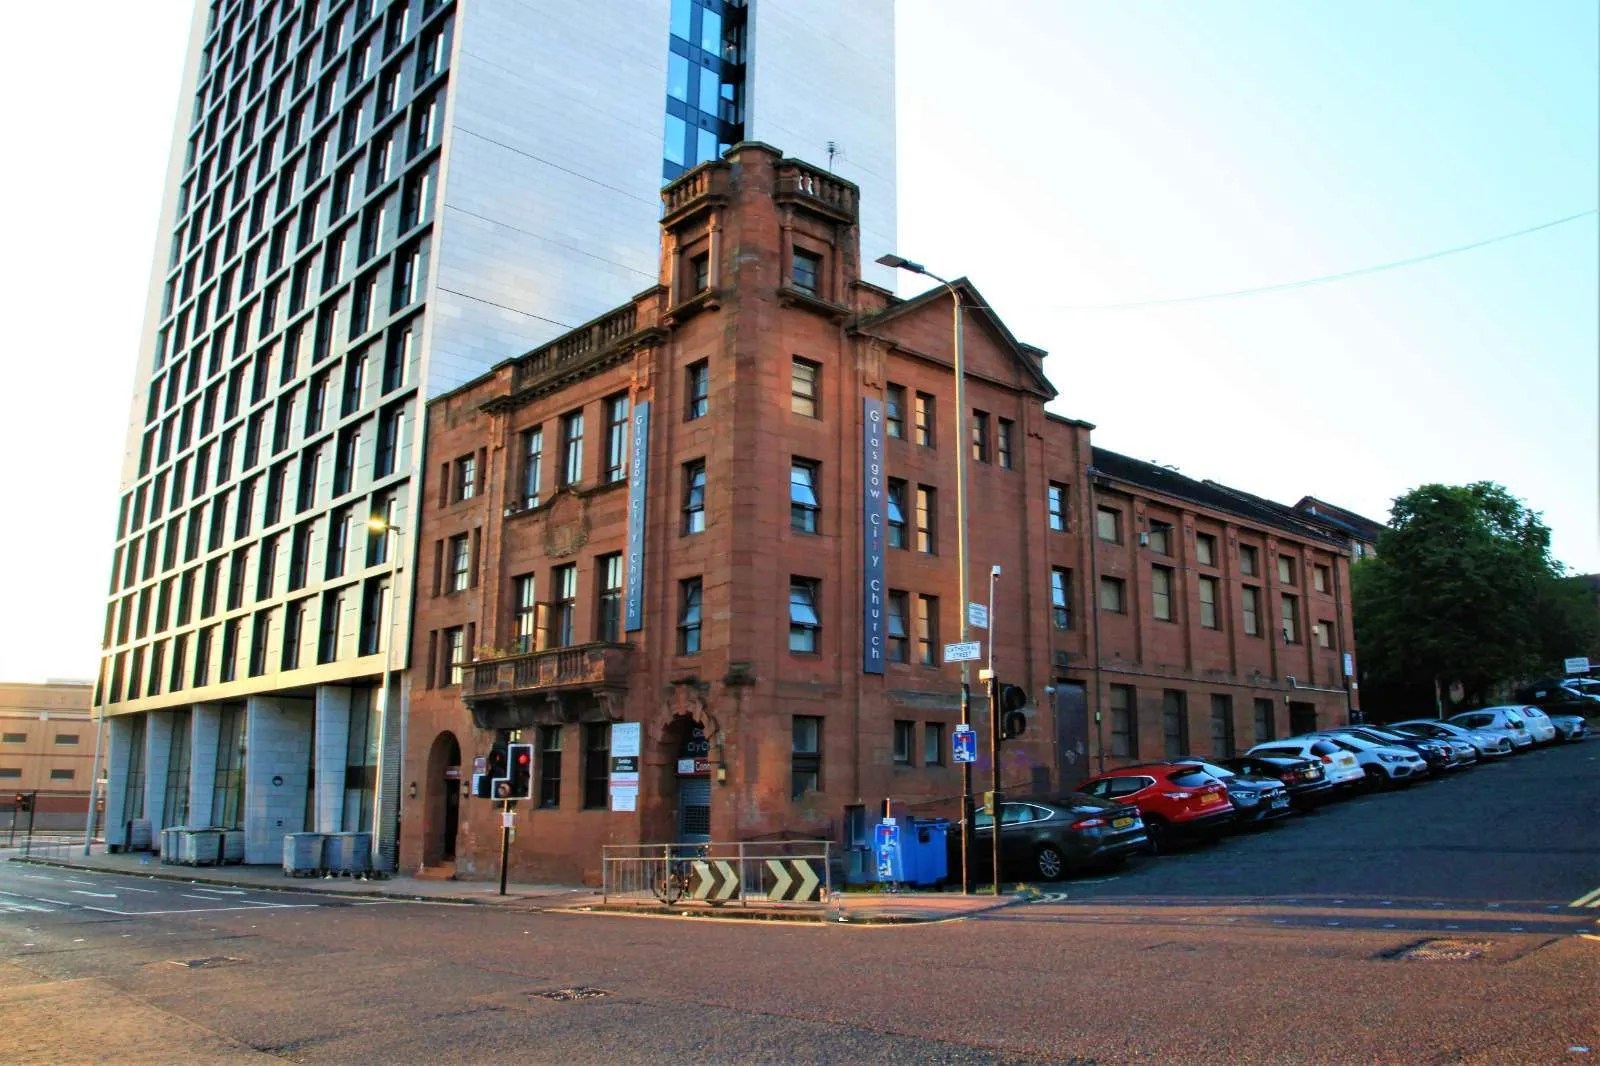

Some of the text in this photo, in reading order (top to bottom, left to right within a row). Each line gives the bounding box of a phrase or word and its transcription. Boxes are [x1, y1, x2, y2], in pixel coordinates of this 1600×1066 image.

[633, 416, 643, 486] Glasgow
[869, 410, 880, 659] Glasgow City Church
[629, 553, 640, 618] Church
